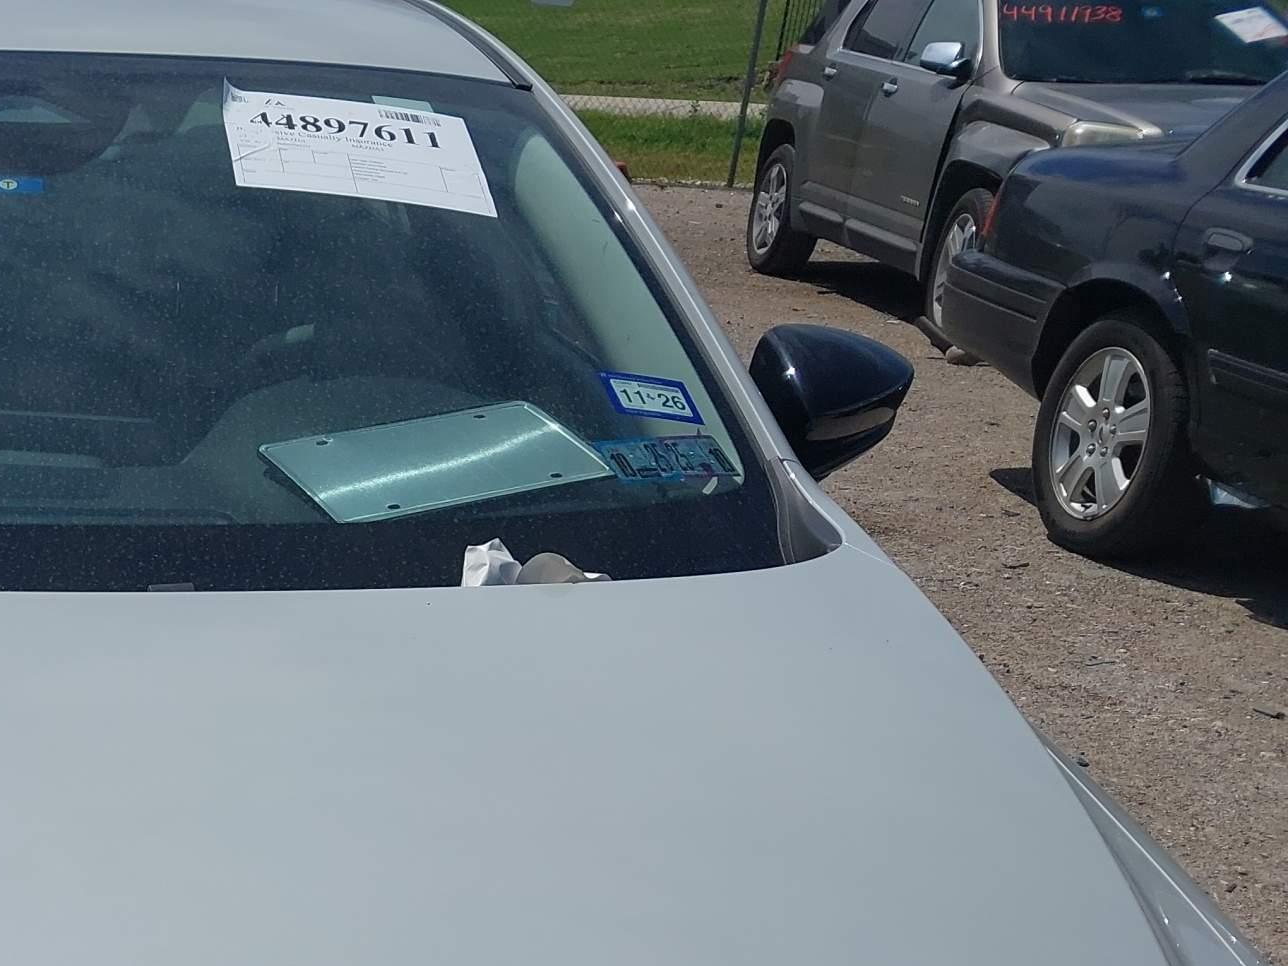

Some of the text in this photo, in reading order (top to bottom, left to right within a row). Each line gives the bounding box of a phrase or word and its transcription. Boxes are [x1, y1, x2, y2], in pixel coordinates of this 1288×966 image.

[1003, 4, 1123, 23] 44911938
[249, 111, 441, 149] 44897611
[620, 389, 687, 411] 11 26
